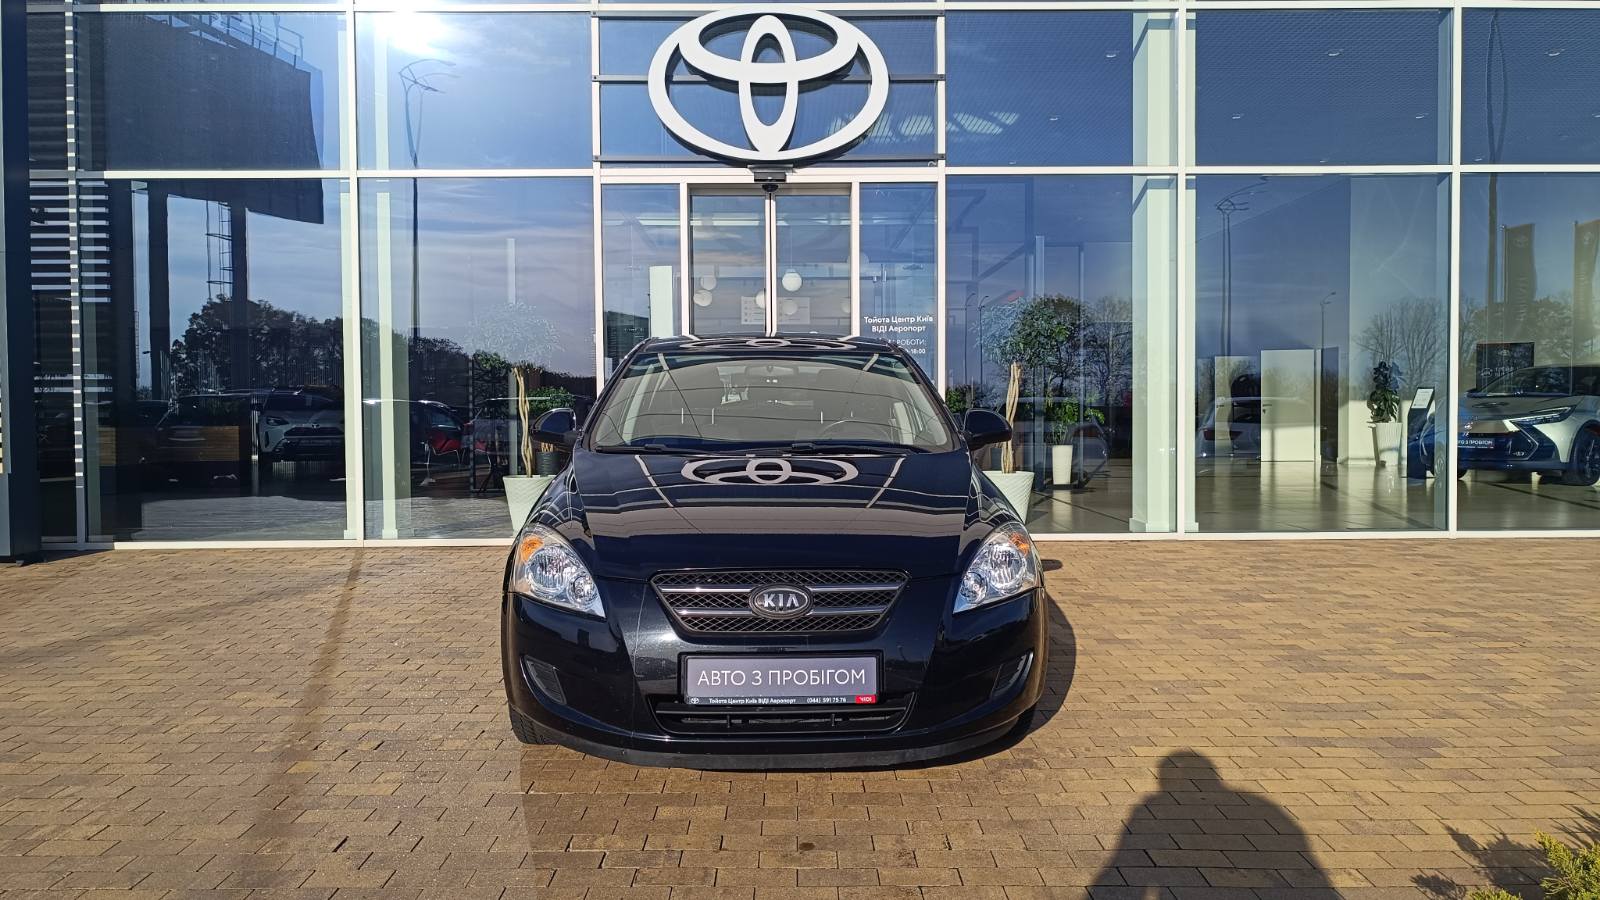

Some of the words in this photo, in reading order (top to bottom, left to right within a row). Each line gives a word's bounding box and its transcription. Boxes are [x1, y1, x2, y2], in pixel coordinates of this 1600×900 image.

[891, 316, 915, 324] Центр
[889, 325, 926, 333] Аеропорт
[763, 593, 799, 608] KIA
[698, 670, 746, 686] АВТО
[751, 670, 762, 686] З
[768, 669, 866, 685] ПРОБІГОМ
